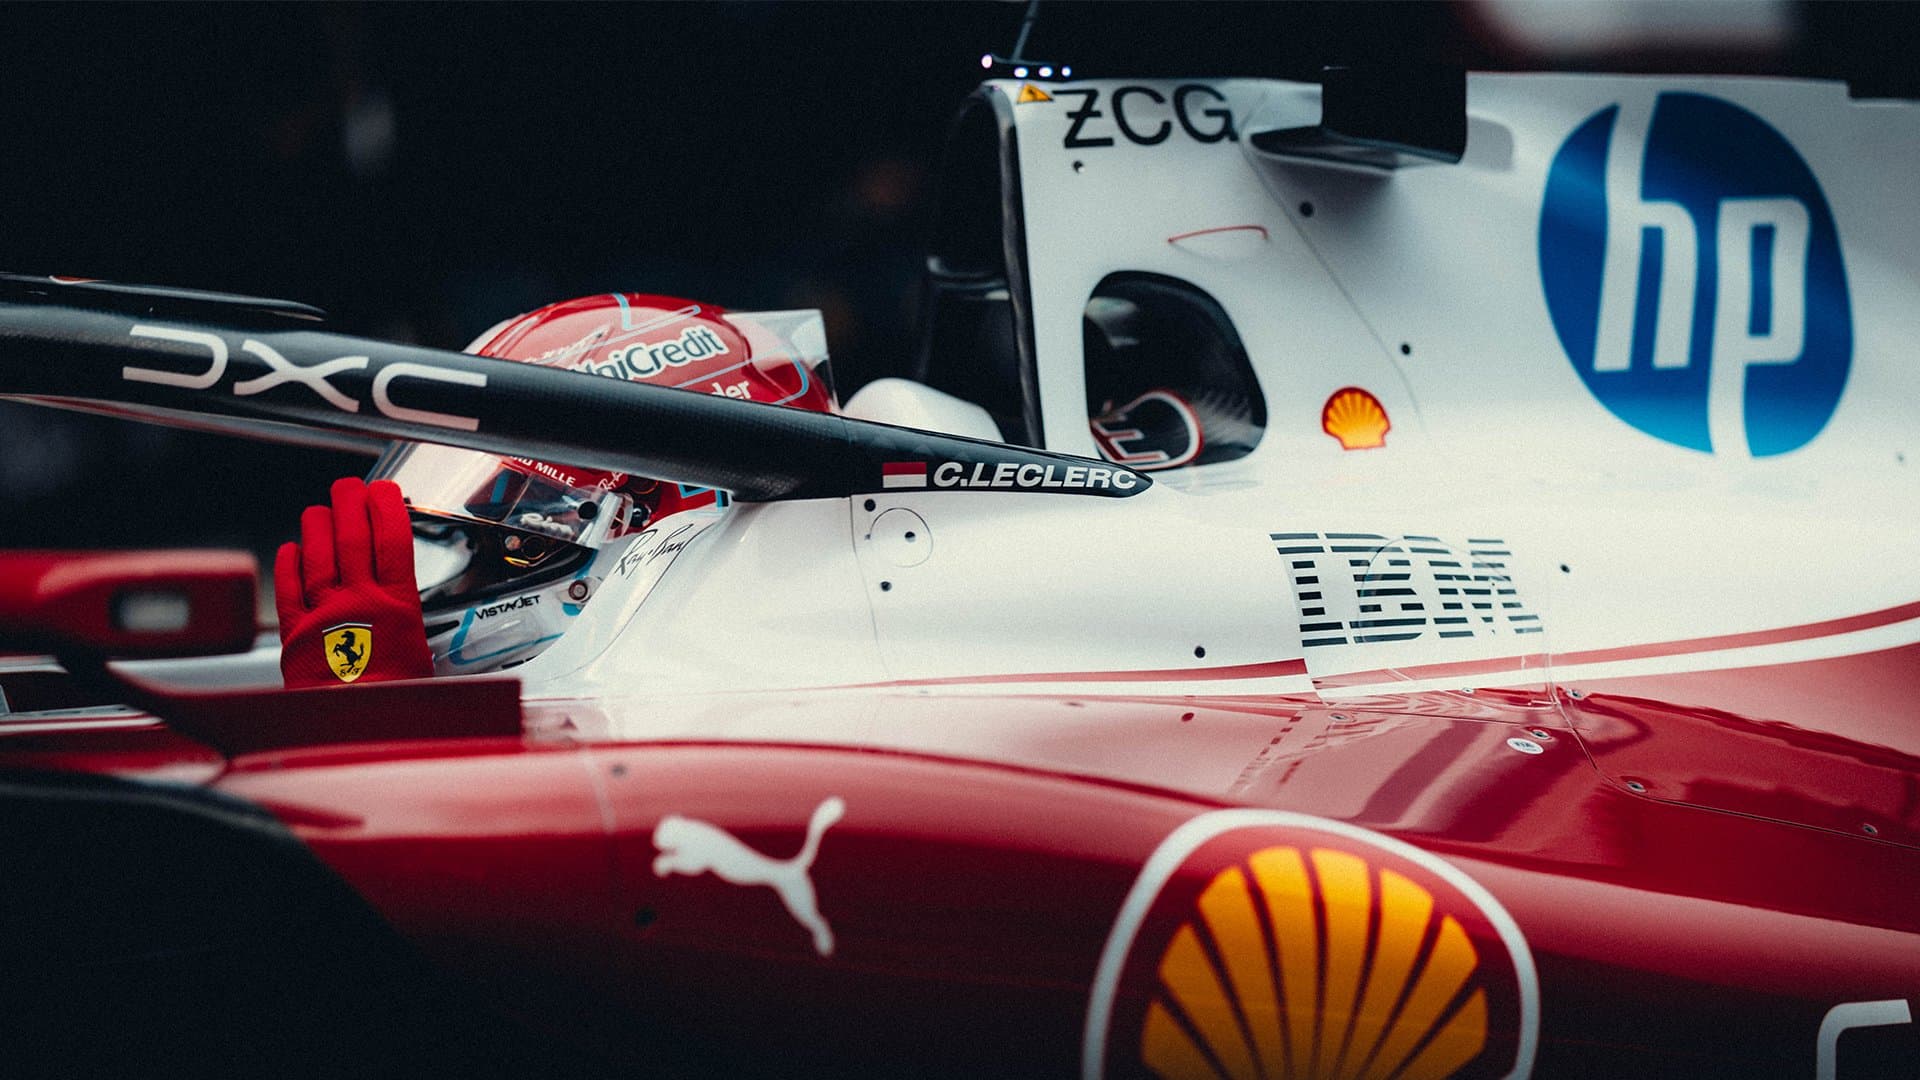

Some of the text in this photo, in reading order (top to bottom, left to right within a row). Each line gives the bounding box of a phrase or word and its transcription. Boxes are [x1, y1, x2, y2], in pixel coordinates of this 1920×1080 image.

[1594, 90, 1811, 458] hp
[122, 325, 488, 431] DXC
[932, 462, 1138, 489] C.LECLERC
[1268, 533, 1544, 648] IBM
